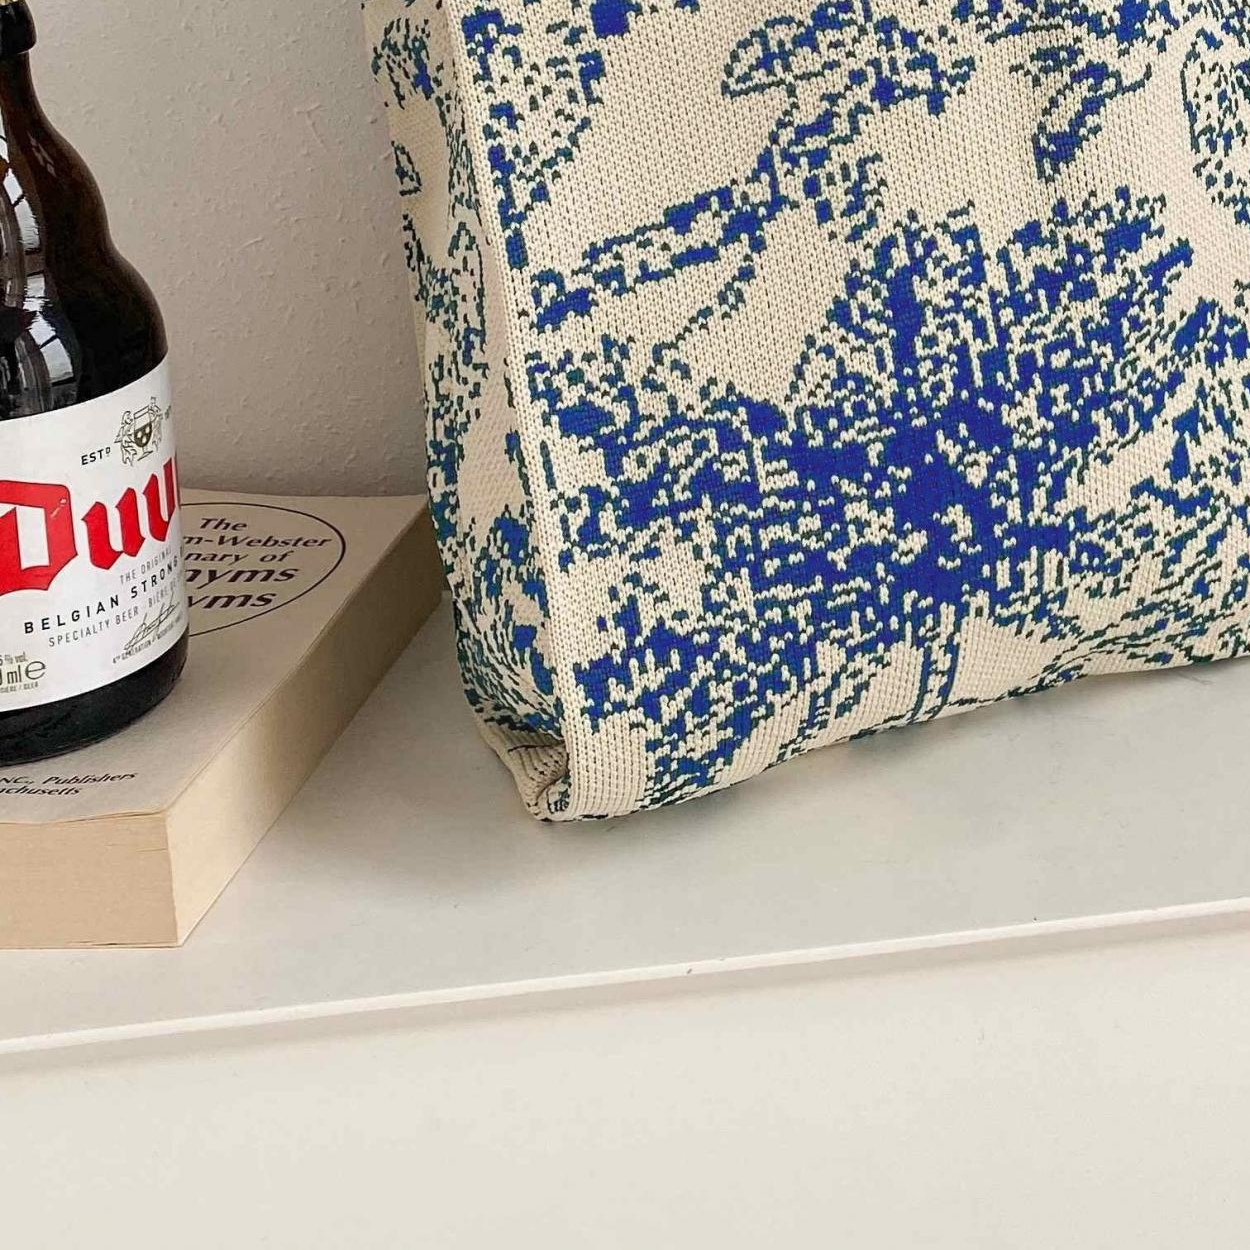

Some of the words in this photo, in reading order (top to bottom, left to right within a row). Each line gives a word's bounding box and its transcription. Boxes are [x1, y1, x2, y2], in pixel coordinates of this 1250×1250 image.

[200, 517, 248, 532] The
[184, 552, 249, 566] nary
[259, 550, 294, 563] of
[24, 594, 120, 635] BELGIAN
[130, 554, 178, 599] STRONG
[49, 619, 111, 648] SPECIALTY
[115, 605, 139, 626] BEER
[7, 664, 22, 685] ml
[42, 771, 139, 785] Publishers
